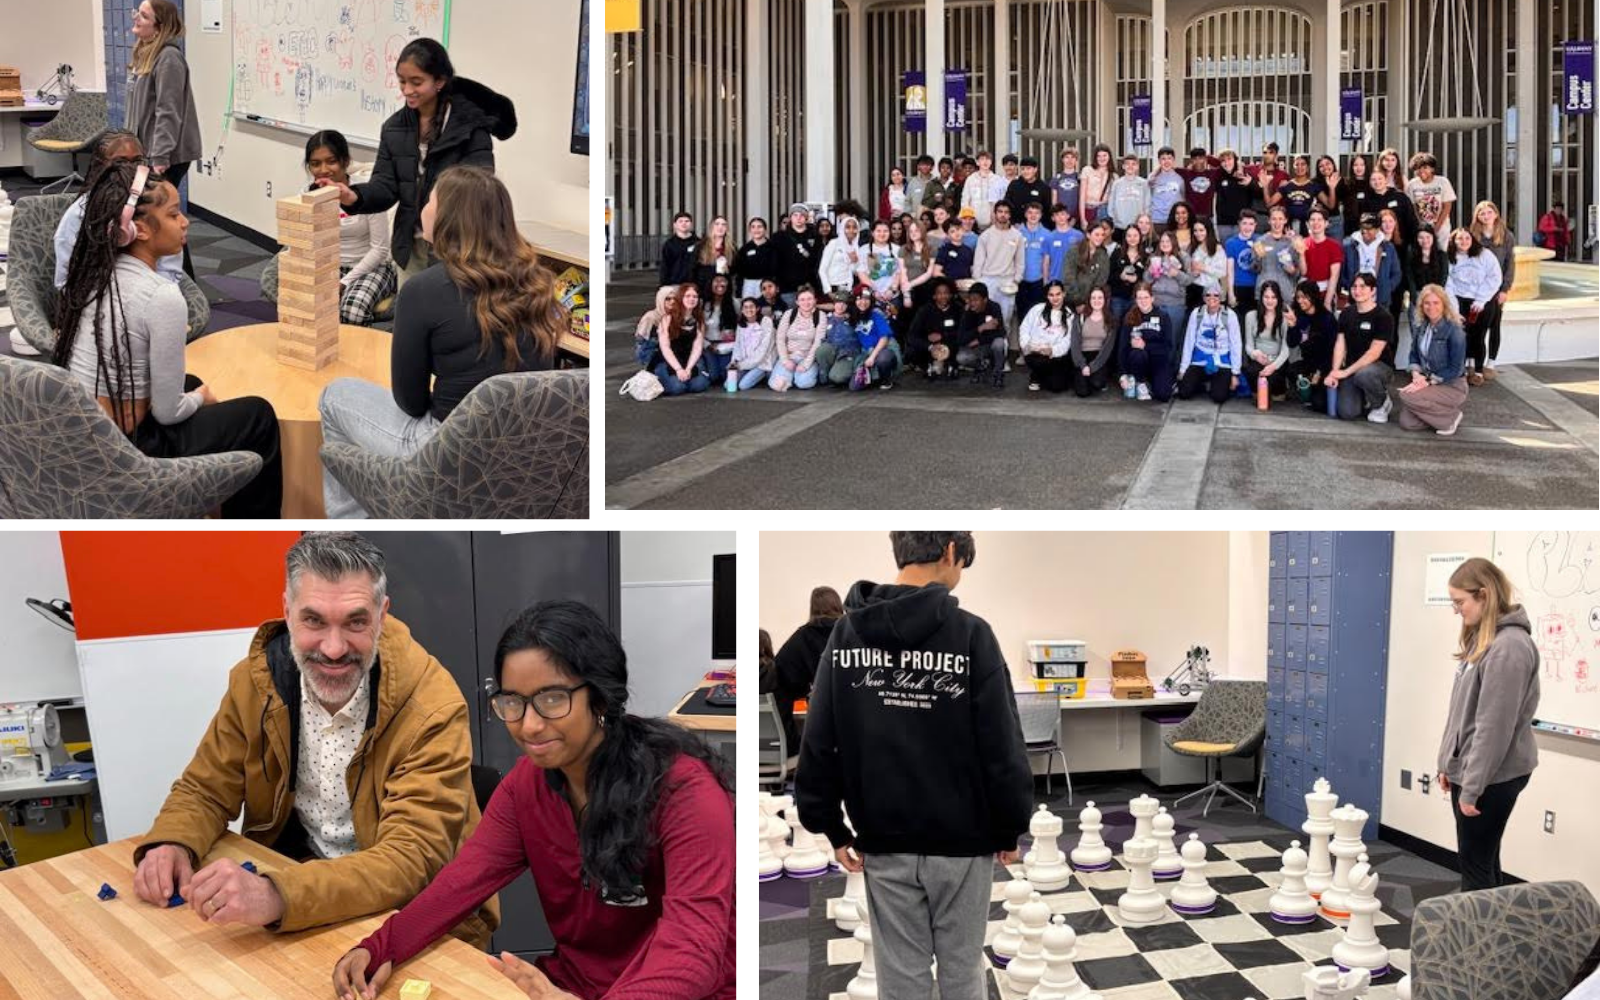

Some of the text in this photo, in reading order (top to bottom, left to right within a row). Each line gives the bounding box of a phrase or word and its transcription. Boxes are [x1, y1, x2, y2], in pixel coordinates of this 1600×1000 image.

[1566, 75, 1581, 110] Campus
[1580, 80, 1592, 109] Center
[946, 98, 956, 127] Campus
[956, 104, 965, 127] Center
[1343, 112, 1352, 137] Campus
[1134, 119, 1143, 142] Campus
[1352, 116, 1361, 137] Center
[832, 648, 893, 668] FUTURE
[851, 668, 965, 699] New York City
